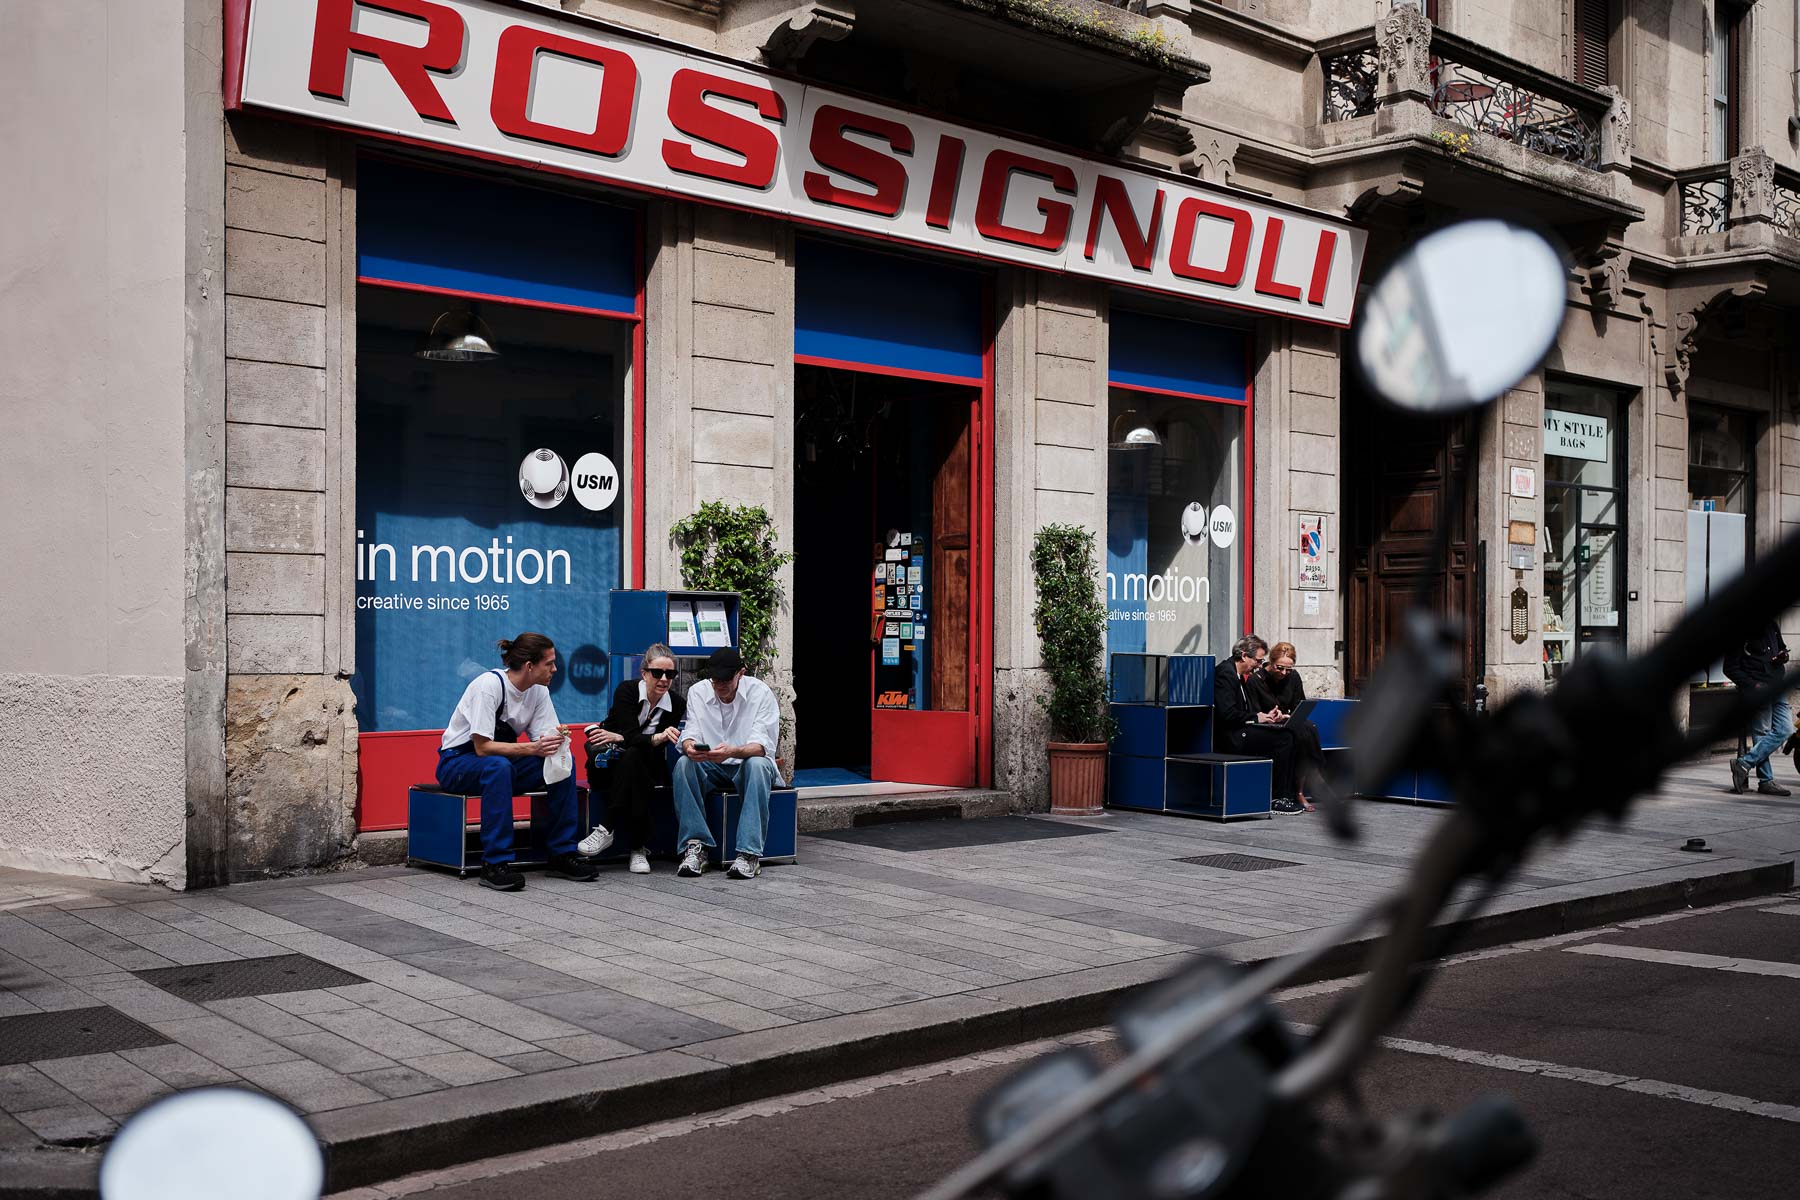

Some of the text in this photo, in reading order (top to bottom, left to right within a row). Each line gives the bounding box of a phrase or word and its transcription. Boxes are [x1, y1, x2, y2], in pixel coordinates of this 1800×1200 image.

[308, 0, 1338, 306] ROSSIGNOLI
[1564, 421, 1604, 439] STYLE
[1560, 436, 1586, 449] BAGS
[576, 473, 614, 492] USM
[1212, 519, 1233, 534] USM
[356, 530, 572, 585] in motion
[1123, 567, 1210, 604] motion
[356, 594, 510, 611] creative since 1965
[1131, 609, 1155, 621] since
[1156, 609, 1177, 622] 1965
[878, 691, 909, 705] KTM
